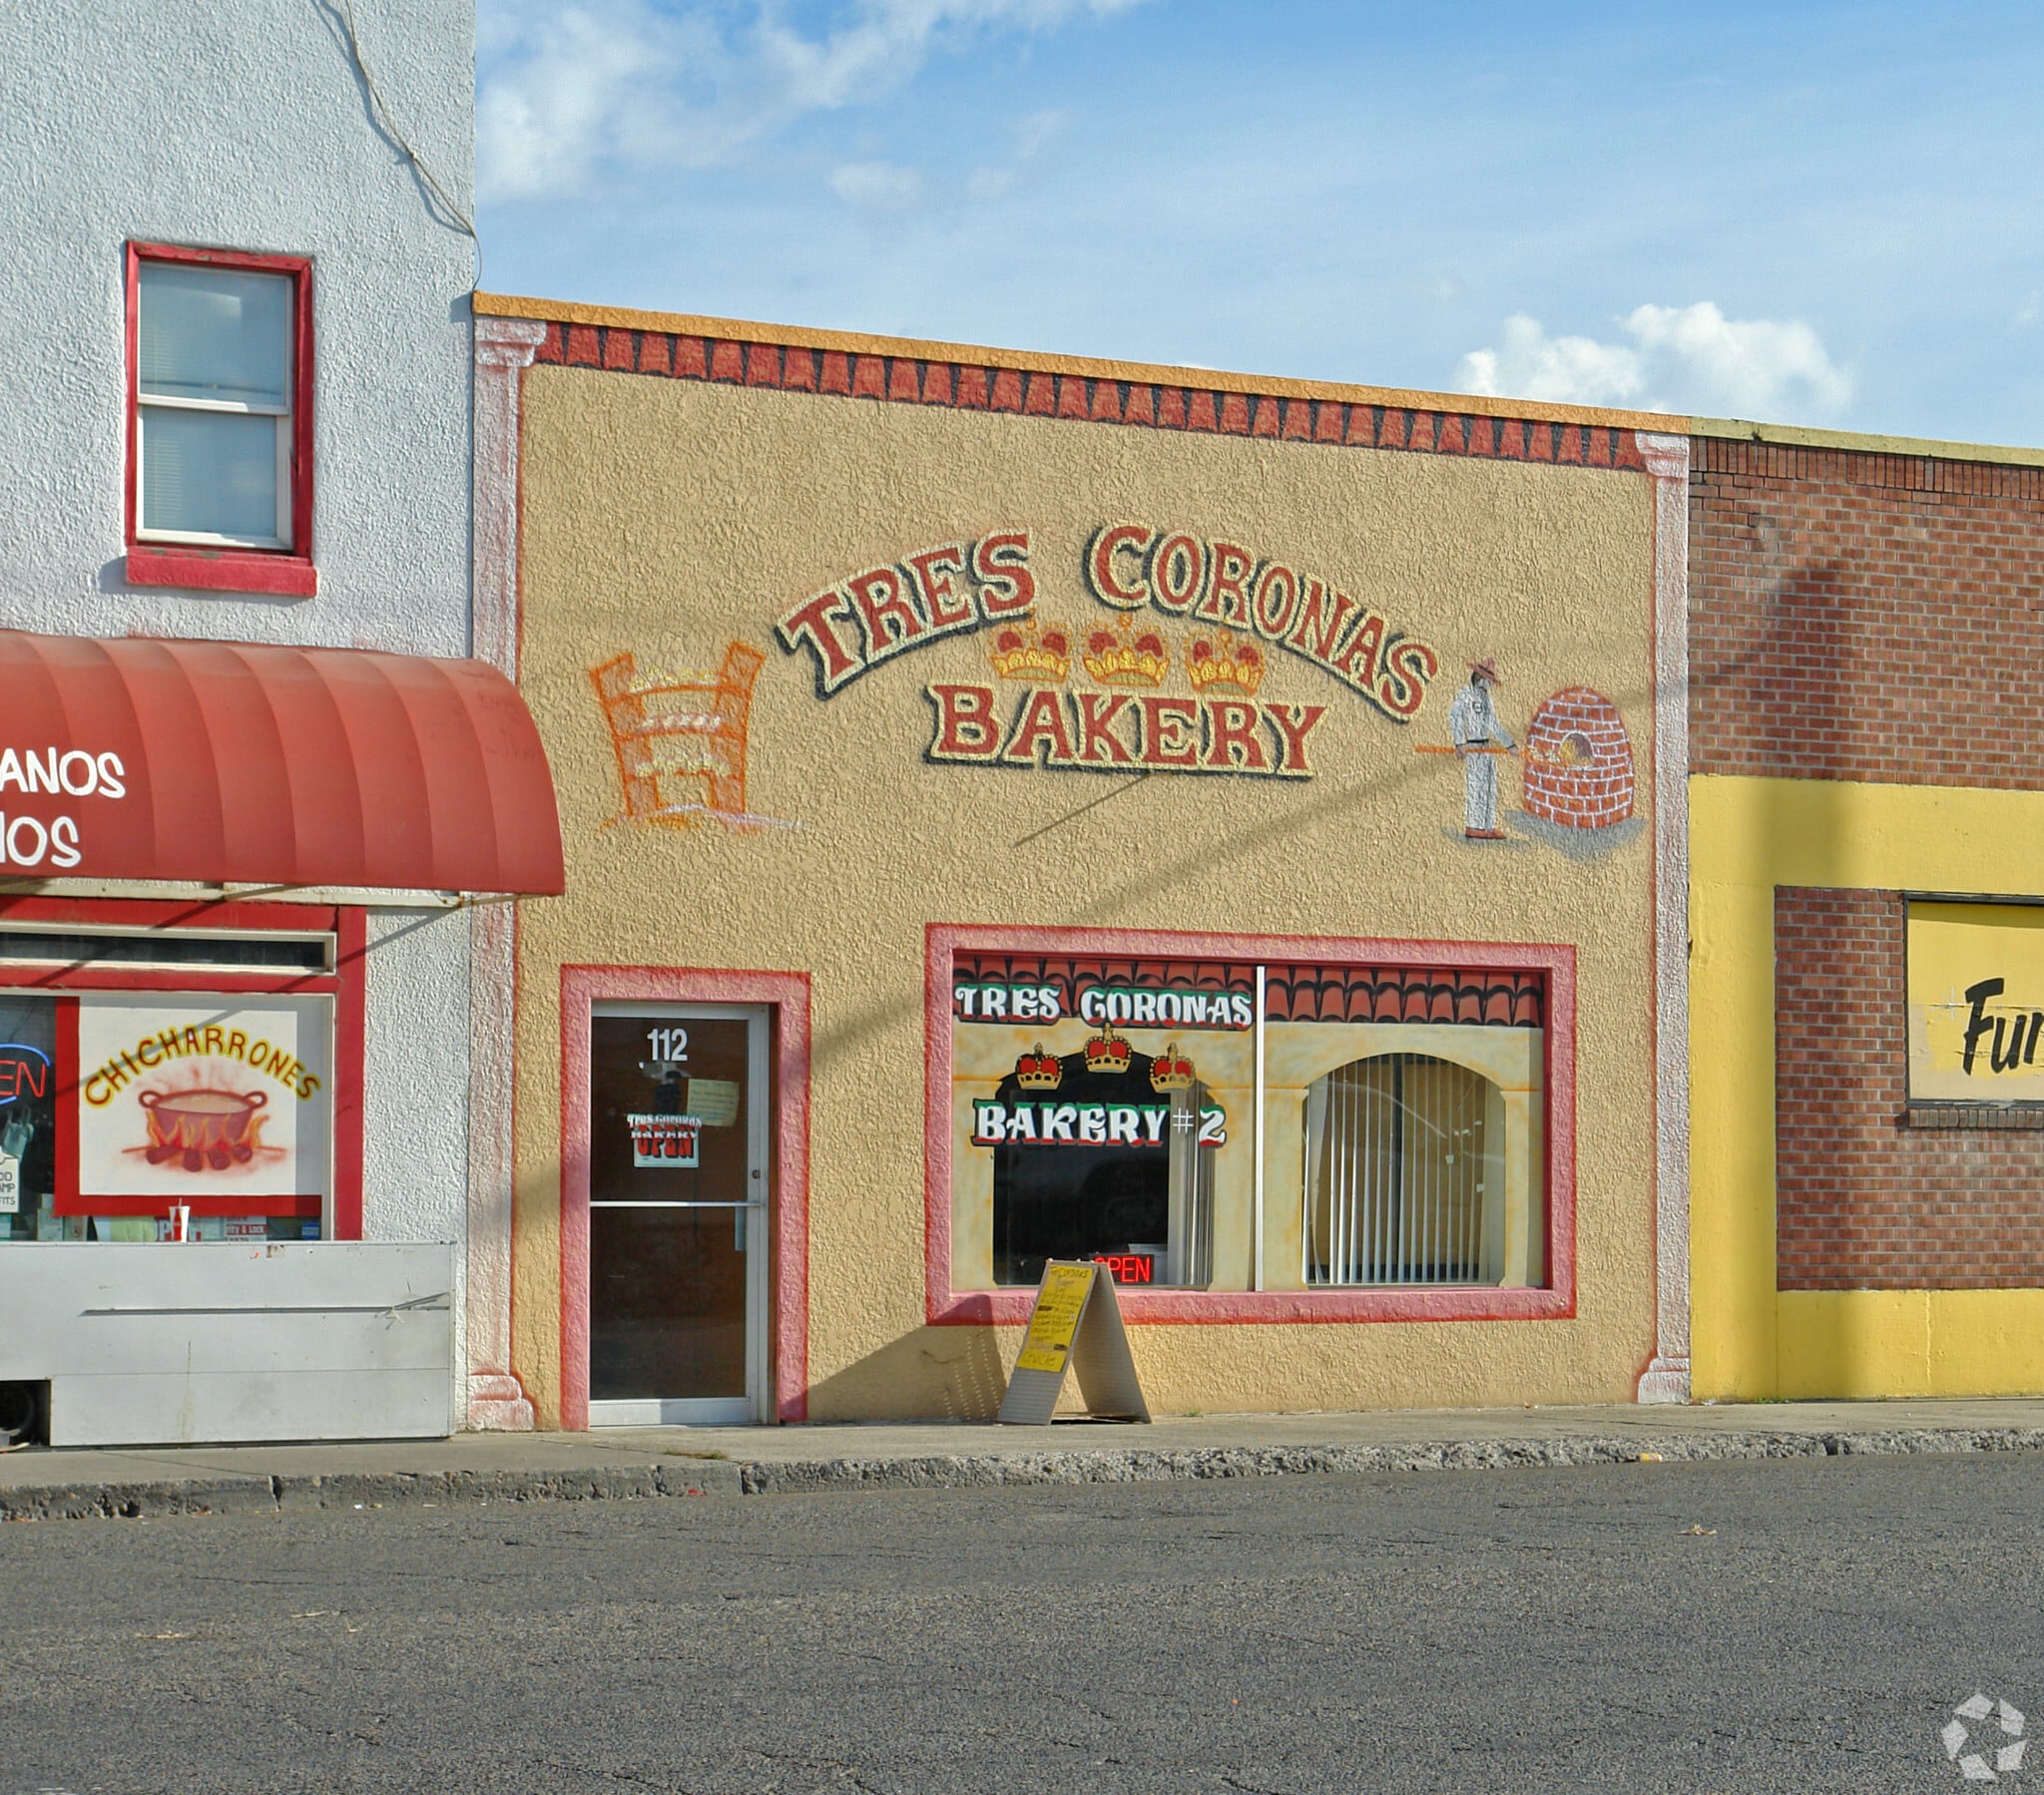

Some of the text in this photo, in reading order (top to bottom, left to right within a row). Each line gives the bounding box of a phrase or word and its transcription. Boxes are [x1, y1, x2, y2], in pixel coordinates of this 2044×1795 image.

[776, 522, 1439, 720] TRES CORONAS
[928, 680, 1328, 776] BAKERY
[0, 746, 126, 799] ANOS
[954, 983, 1061, 1023] TRES
[84, 1023, 321, 1109] CHICHARRONES
[647, 1028, 688, 1062] 112
[972, 1099, 1172, 1146] BAKERY
[1094, 1255, 1152, 1283] PEN
